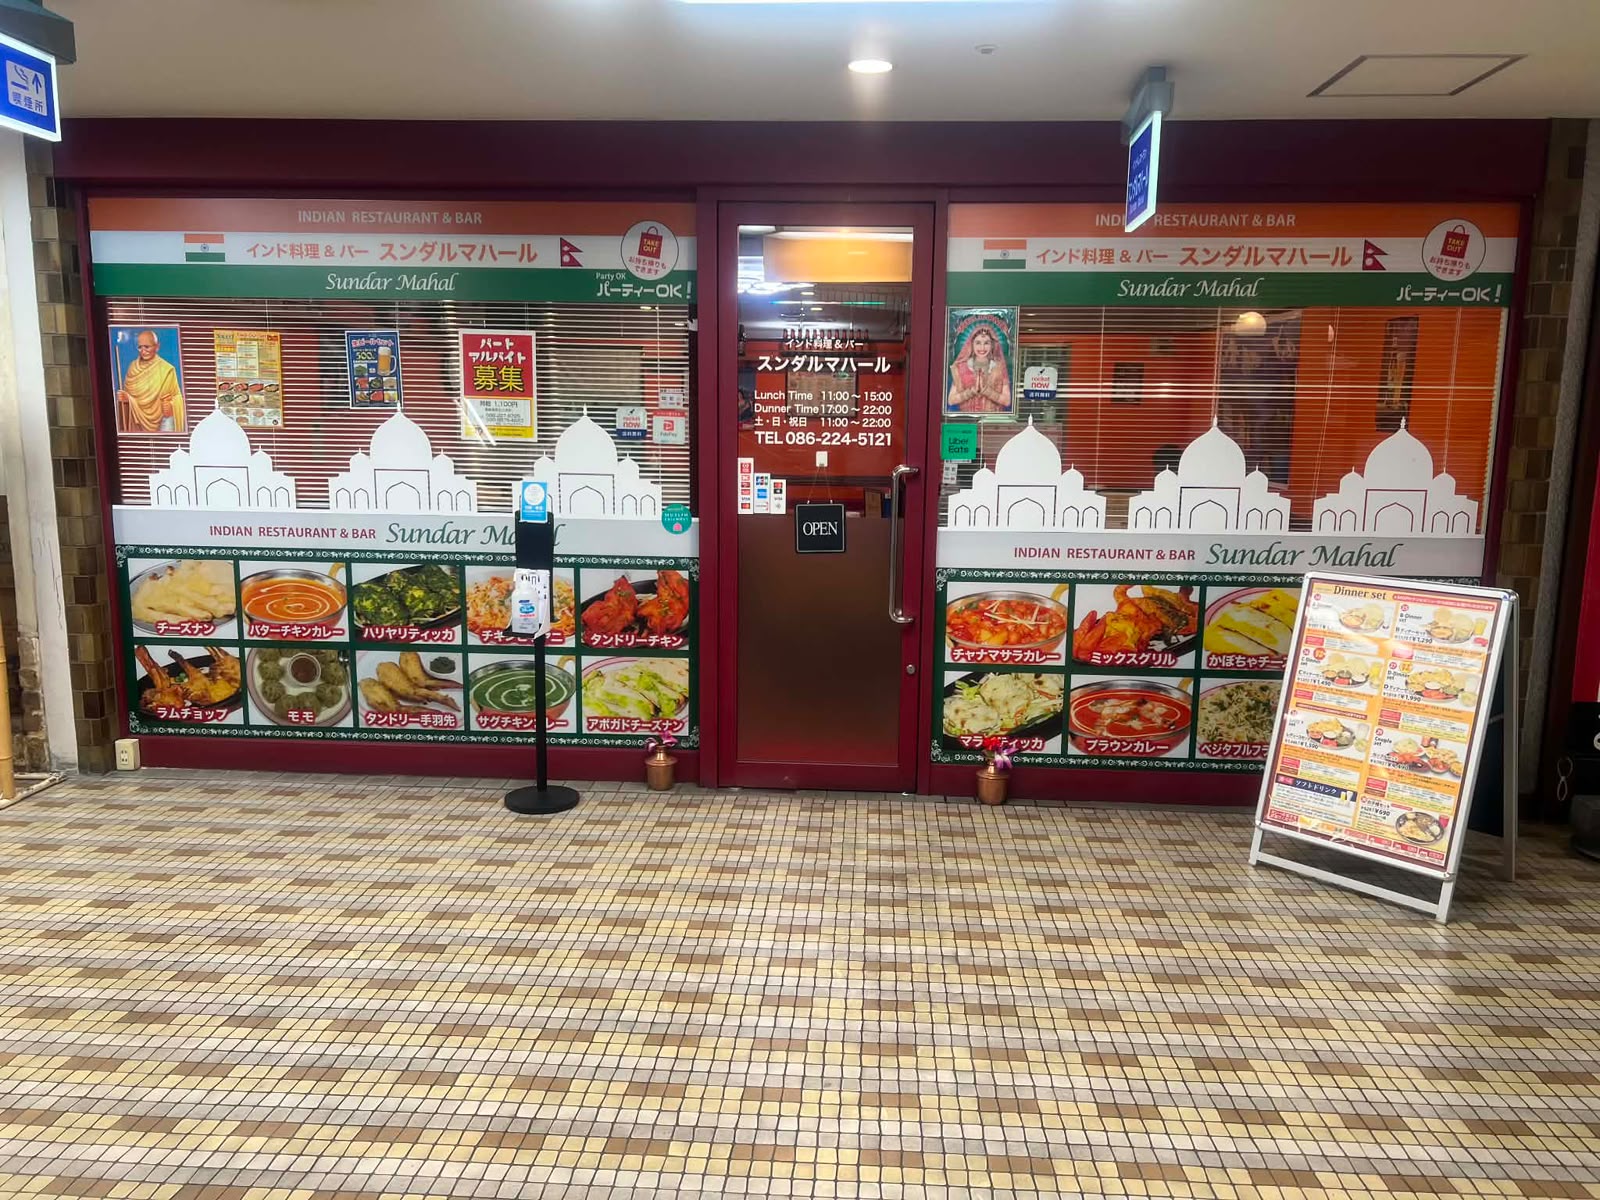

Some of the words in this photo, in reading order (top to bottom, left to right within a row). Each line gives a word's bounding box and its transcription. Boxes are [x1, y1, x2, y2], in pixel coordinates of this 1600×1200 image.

[298, 210, 346, 223] INDIAN
[352, 211, 439, 224] RESTAURANT
[442, 212, 452, 224] &
[455, 212, 482, 224] BAR
[1154, 215, 1249, 227] RESTAURANT
[1252, 215, 1262, 227] &
[1266, 214, 1296, 226] BAR
[247, 243, 321, 259] インド料理
[340, 244, 369, 258] バー
[379, 241, 538, 262] スンダルマハール
[1036, 248, 1115, 264] インド料理
[1136, 249, 1169, 263] バー
[1179, 246, 1353, 267] スンダルマハール
[325, 271, 393, 291] Sundar
[395, 272, 460, 291] Mahal
[596, 272, 613, 281] Party
[615, 272, 626, 281] OK
[1117, 277, 1192, 297] Sundar
[1193, 278, 1265, 298] Mahal
[480, 337, 514, 350] パート
[785, 339, 832, 349] インド料理
[845, 340, 864, 349] バー
[468, 351, 526, 364] アルバイト
[757, 355, 891, 373] スンダルマハール
[473, 365, 524, 392] 募集
[754, 391, 785, 400] Lunch
[788, 391, 813, 400] Time
[821, 391, 849, 401] 11:00
[864, 391, 893, 401] 15:00
[754, 404, 791, 413] Dunner
[794, 404, 819, 414] Time
[821, 405, 849, 414] 17:00
[862, 405, 892, 415] 22:00
[820, 418, 849, 427] 11:00
[862, 418, 892, 428] 22:00
[755, 431, 783, 444] TEL
[785, 432, 892, 446] 086-224-5121
[948, 437, 969, 445] Uber
[948, 446, 969, 454] Eats
[209, 526, 253, 536] INDIAN
[258, 526, 337, 538] RESTAURANT
[339, 528, 349, 539] &
[352, 528, 376, 539] BAR
[386, 521, 476, 545] Sundar
[802, 521, 838, 536] OPEN
[1014, 547, 1060, 558] INDIAN
[1066, 548, 1152, 560] RESTAURANT
[1155, 550, 1166, 560] &
[1169, 550, 1196, 561] BAR
[1206, 541, 1304, 566] Sundar
[1308, 543, 1404, 567] Mahal
[1333, 585, 1370, 598] Dinner
[1371, 591, 1387, 600] set
[156, 622, 215, 635] チーズナン
[250, 625, 344, 637] バターチキンカレー
[363, 628, 454, 641] ハリヤリティッカ
[590, 634, 683, 647] タンドリーチキン
[952, 649, 1060, 663] チャナマサラカレー
[1091, 652, 1176, 666] ミックスグリル
[157, 707, 228, 720] ラムチョップ
[287, 711, 314, 723] モモ
[366, 714, 456, 726] タンドリー手羽先
[478, 714, 568, 727] サグチキンレー
[588, 718, 683, 731] アボガドチーズナン
[1086, 739, 1169, 752] ブラウンカレー
[1296, 780, 1337, 794] ソフトドリンク
